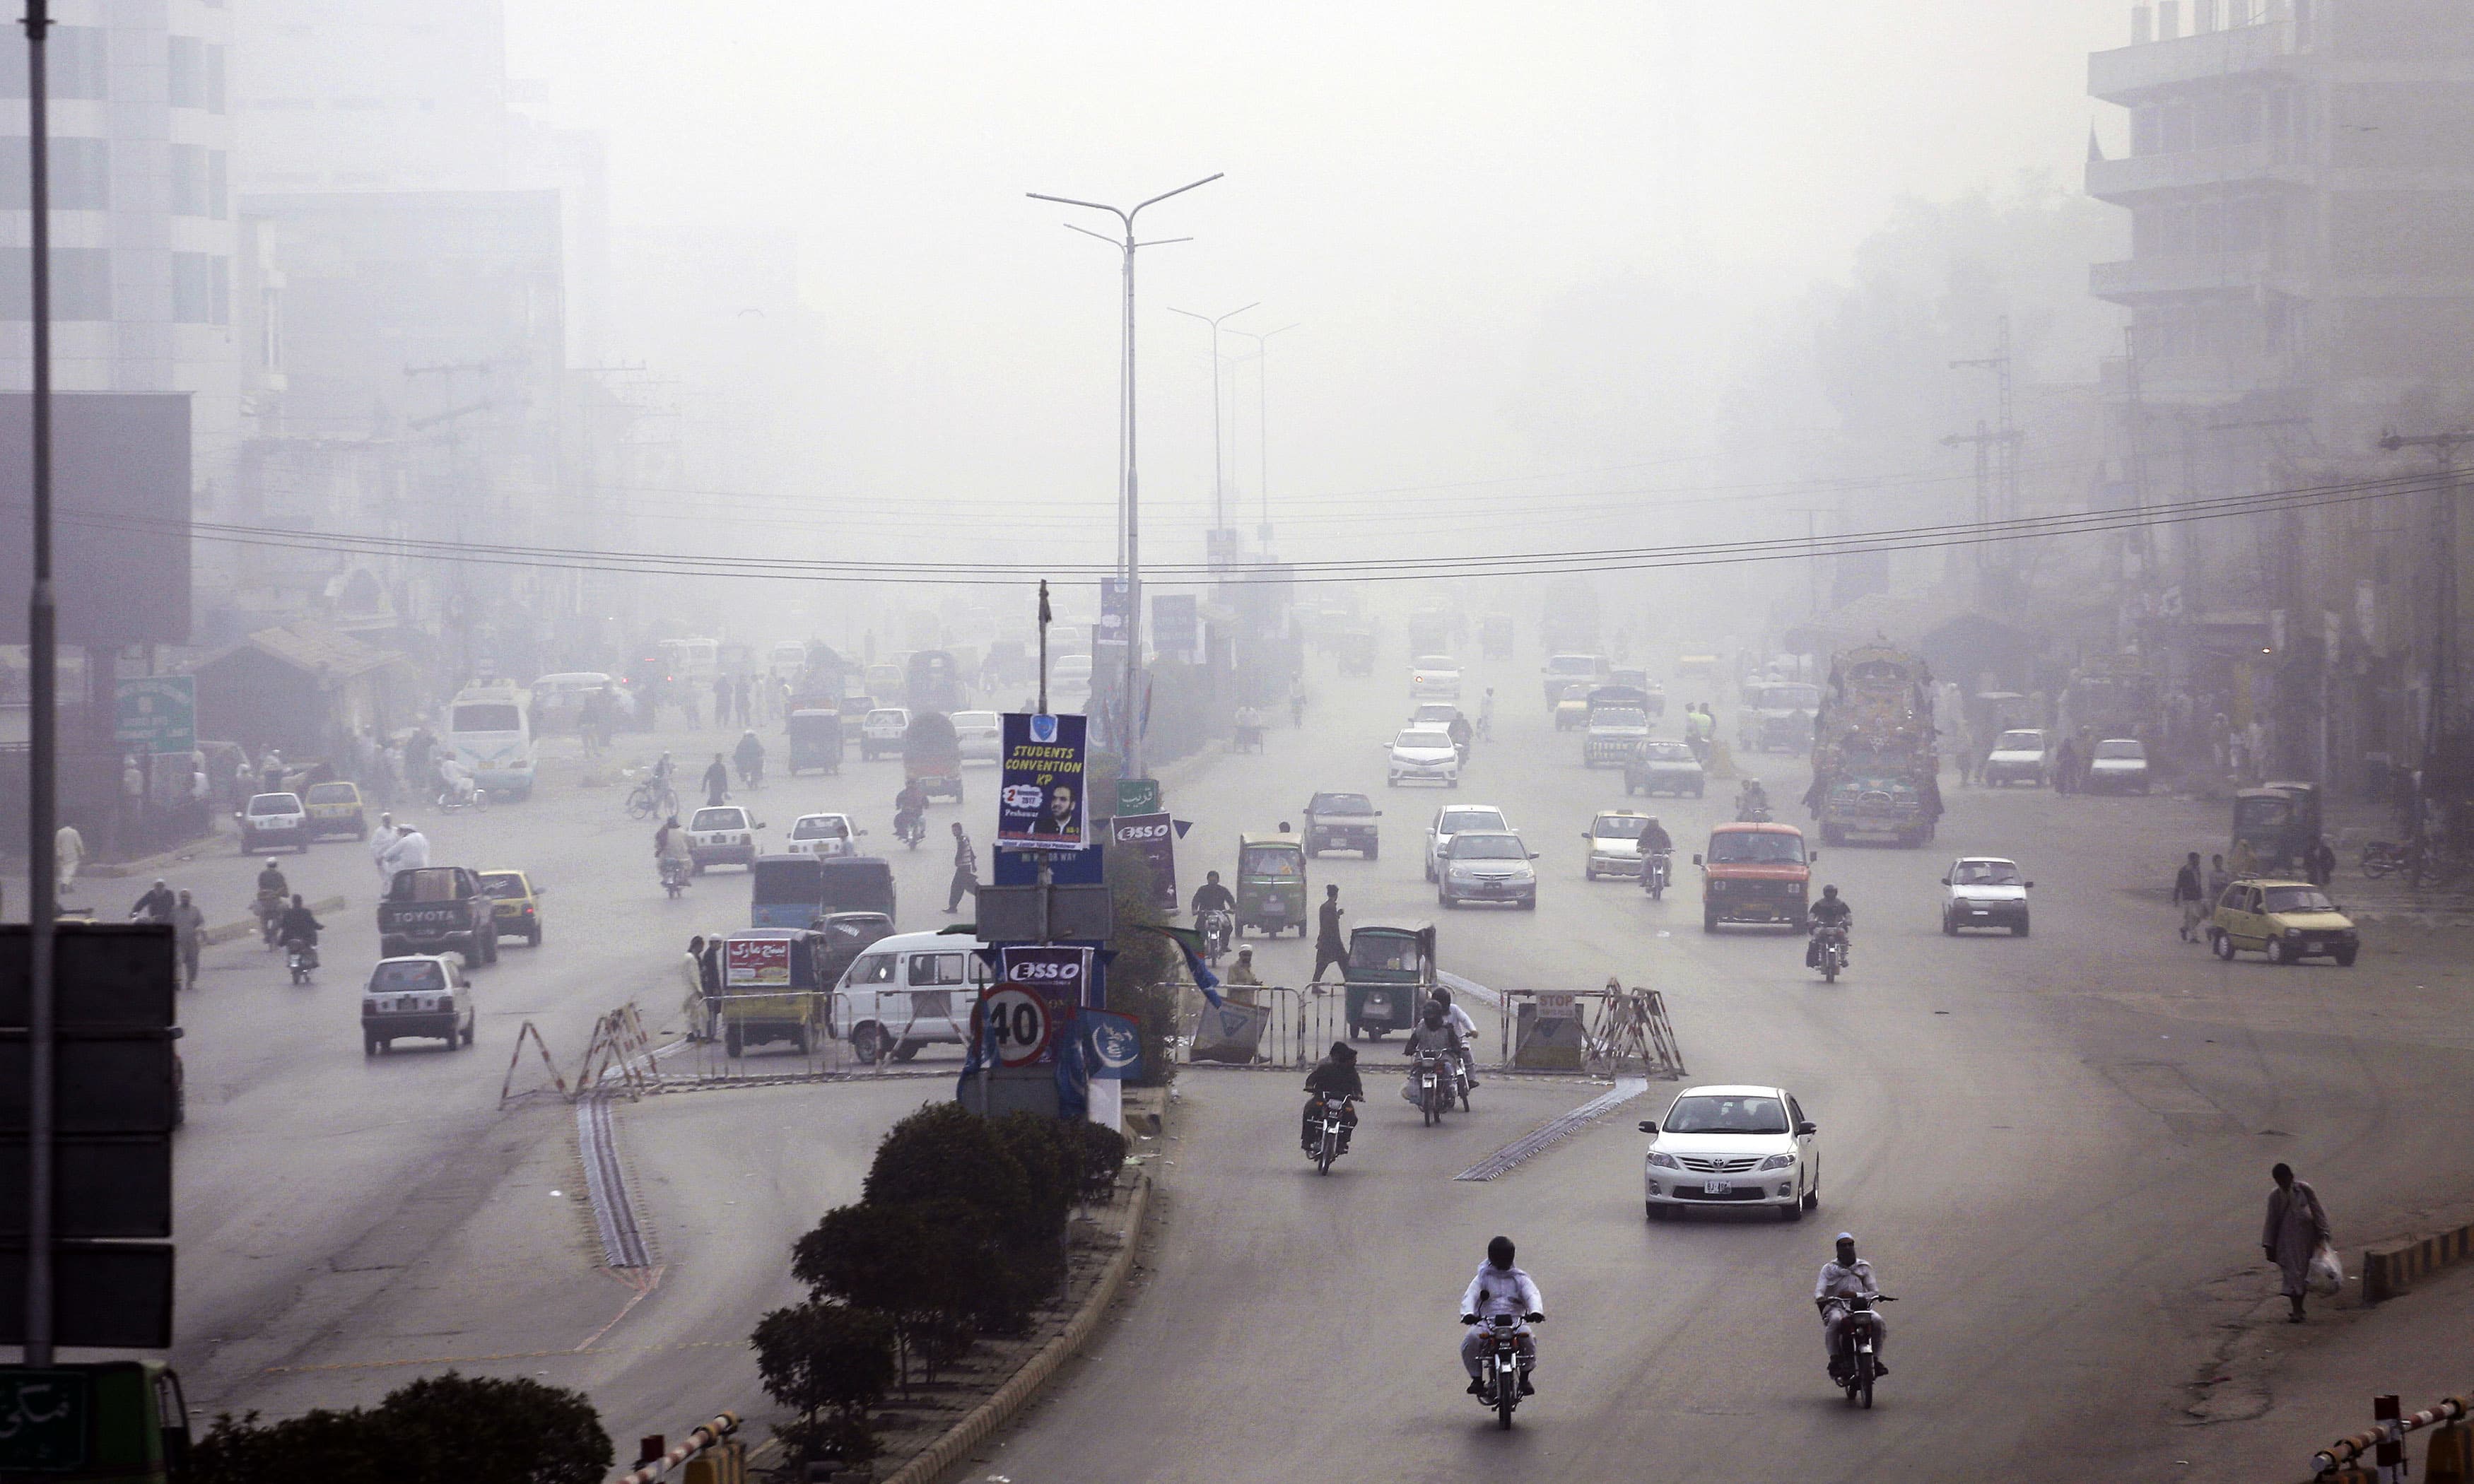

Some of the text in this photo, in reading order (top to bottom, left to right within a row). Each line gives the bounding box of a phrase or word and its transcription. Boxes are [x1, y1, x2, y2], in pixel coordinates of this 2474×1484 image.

[1013, 746, 1074, 759] STUDENTS
[1005, 760, 1082, 773] CONVENTION
[1036, 774, 1053, 785] KP
[1007, 789, 1016, 801] 2
[1117, 824, 1168, 841] ESSO
[393, 911, 454, 922] TOYOTA
[1009, 962, 1079, 981] ESSO
[1540, 994, 1573, 1007] STOP
[990, 1002, 1039, 1046] 40
